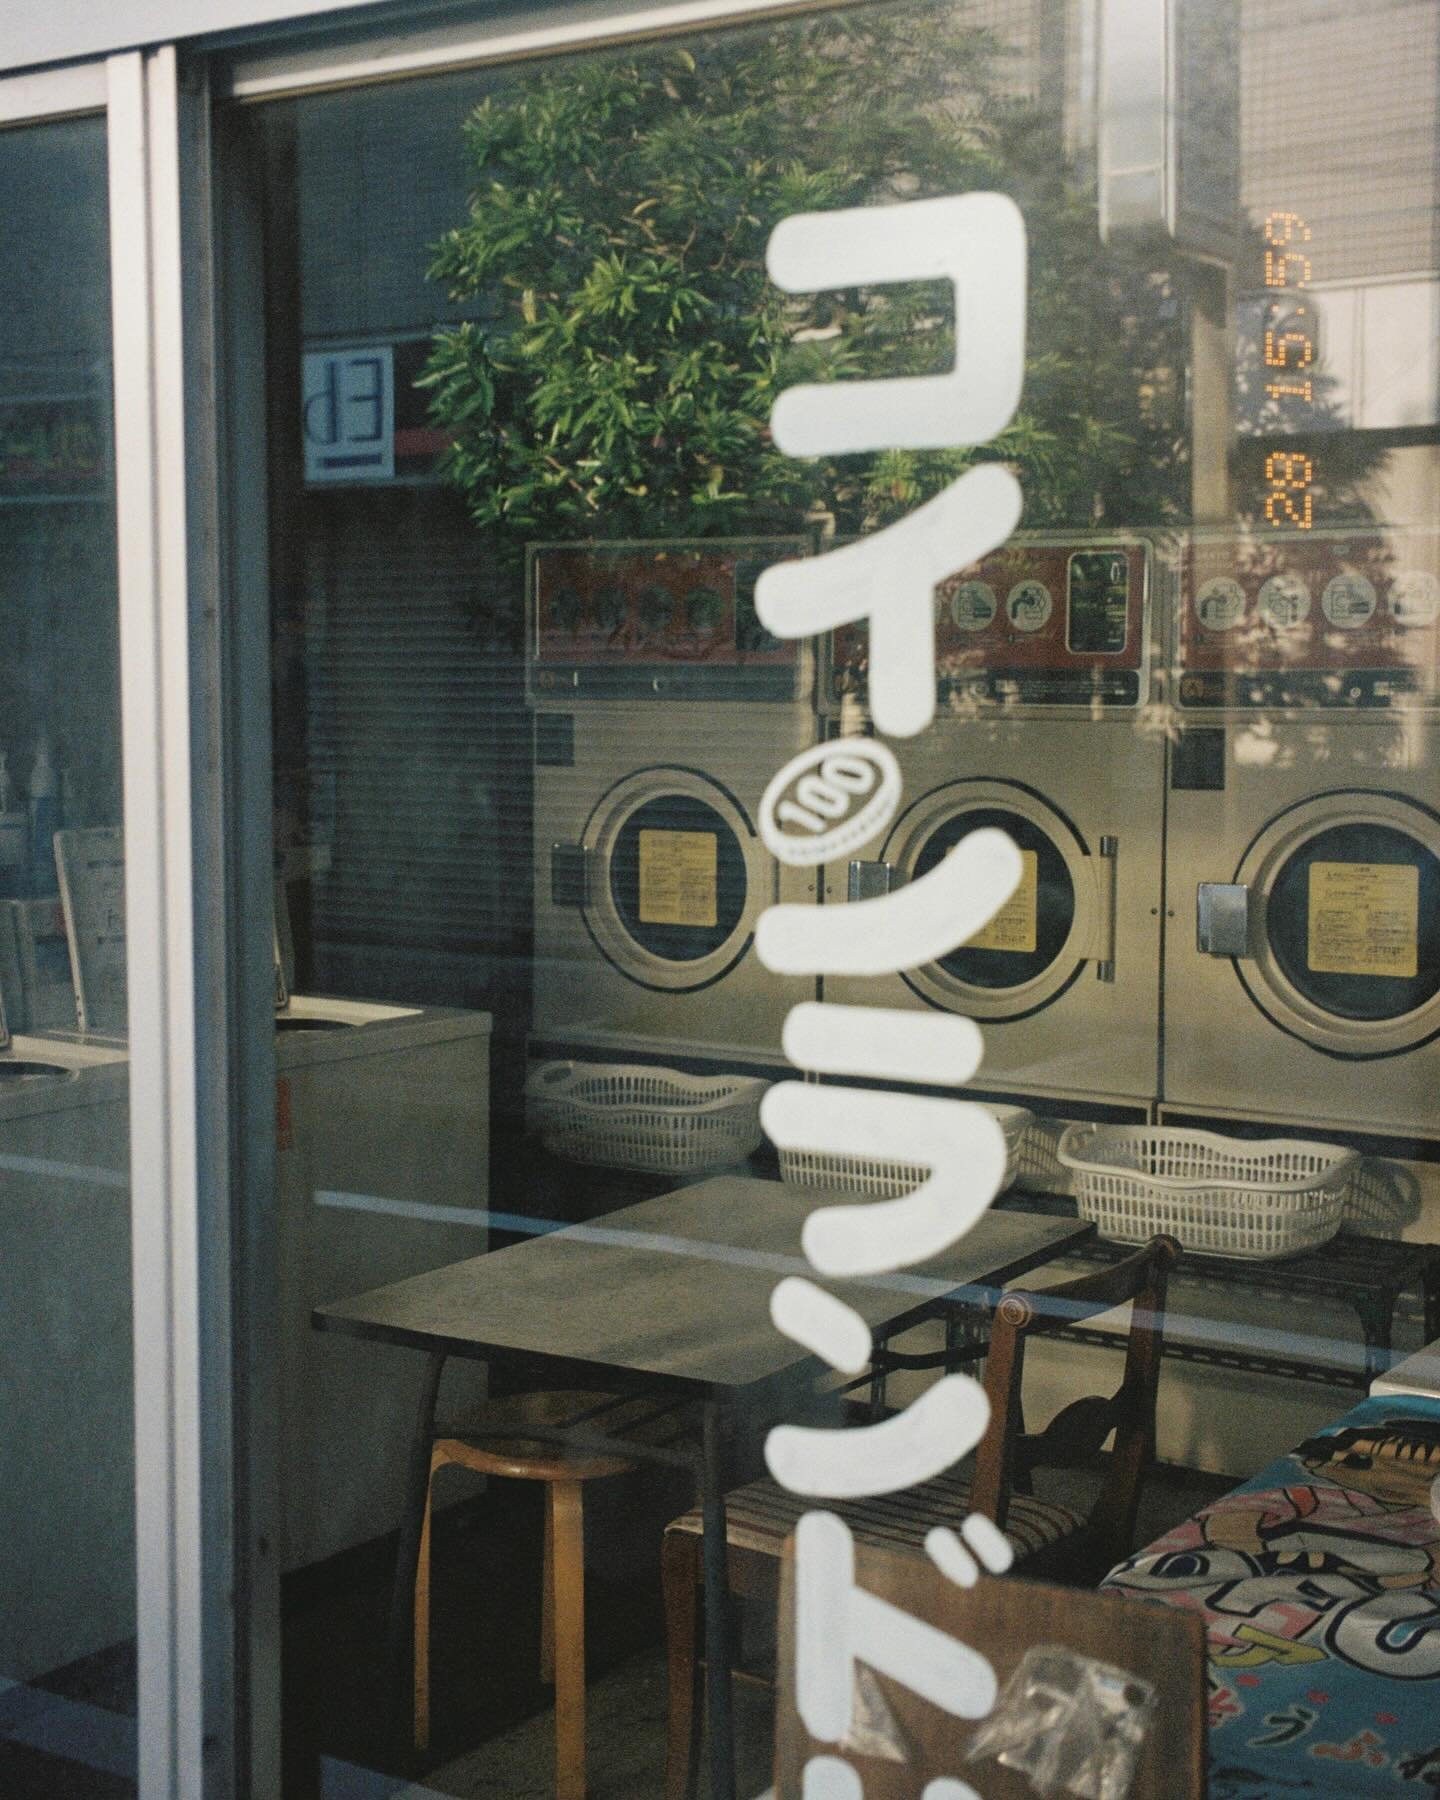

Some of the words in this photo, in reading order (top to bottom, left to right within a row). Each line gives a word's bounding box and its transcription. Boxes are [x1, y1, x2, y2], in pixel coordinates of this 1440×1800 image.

[754, 190, 1027, 1800] コインランド
[777, 757, 876, 833] 100
